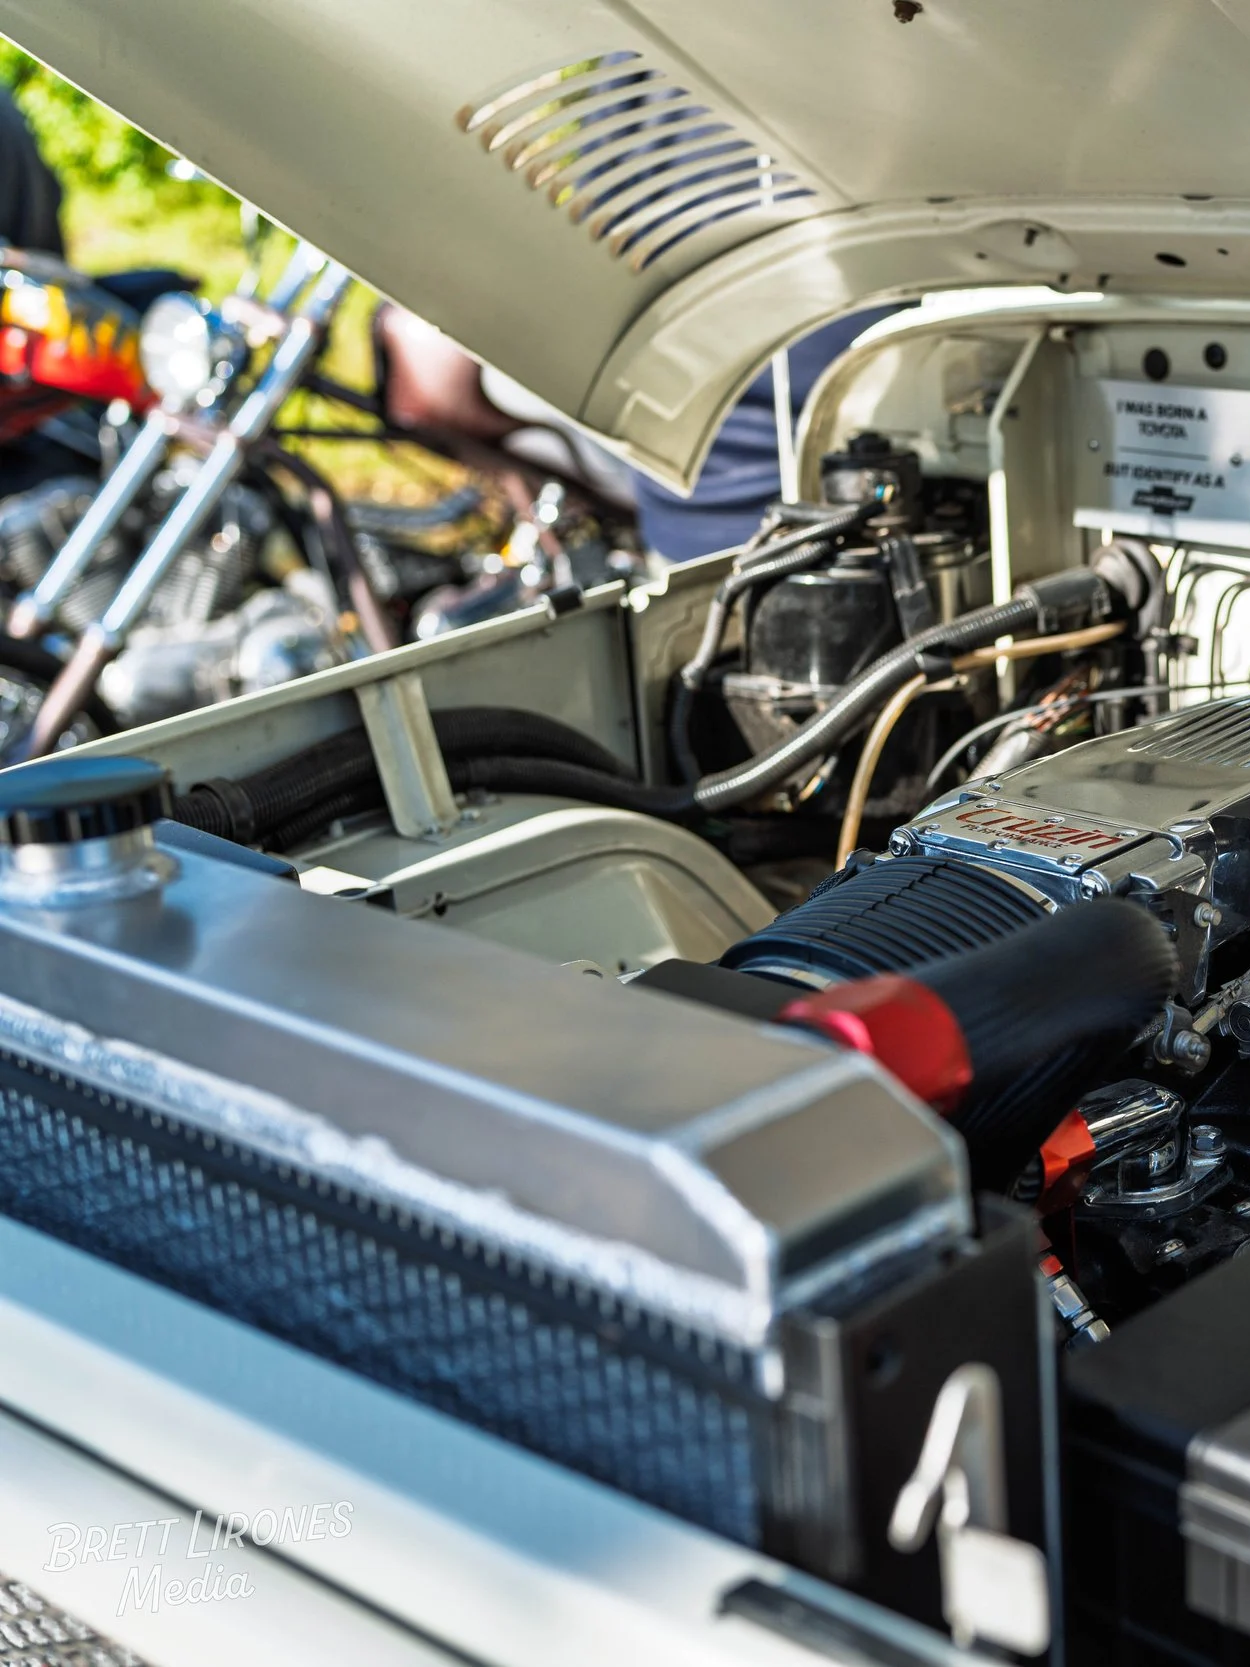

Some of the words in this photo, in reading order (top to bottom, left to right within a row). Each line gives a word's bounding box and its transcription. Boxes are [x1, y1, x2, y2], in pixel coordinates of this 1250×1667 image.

[1125, 402, 1153, 416] WAS
[1157, 404, 1195, 419] BORN
[1198, 407, 1208, 422] A
[1138, 421, 1188, 439] TOYOTA
[1103, 462, 1129, 478] BUT
[1132, 465, 1192, 485] IDENTIFY
[1193, 473, 1211, 488] AS
[1214, 475, 1225, 489] A
[955, 808, 1124, 849] Cruzin
[960, 823, 1069, 849] PERFORMANCE
